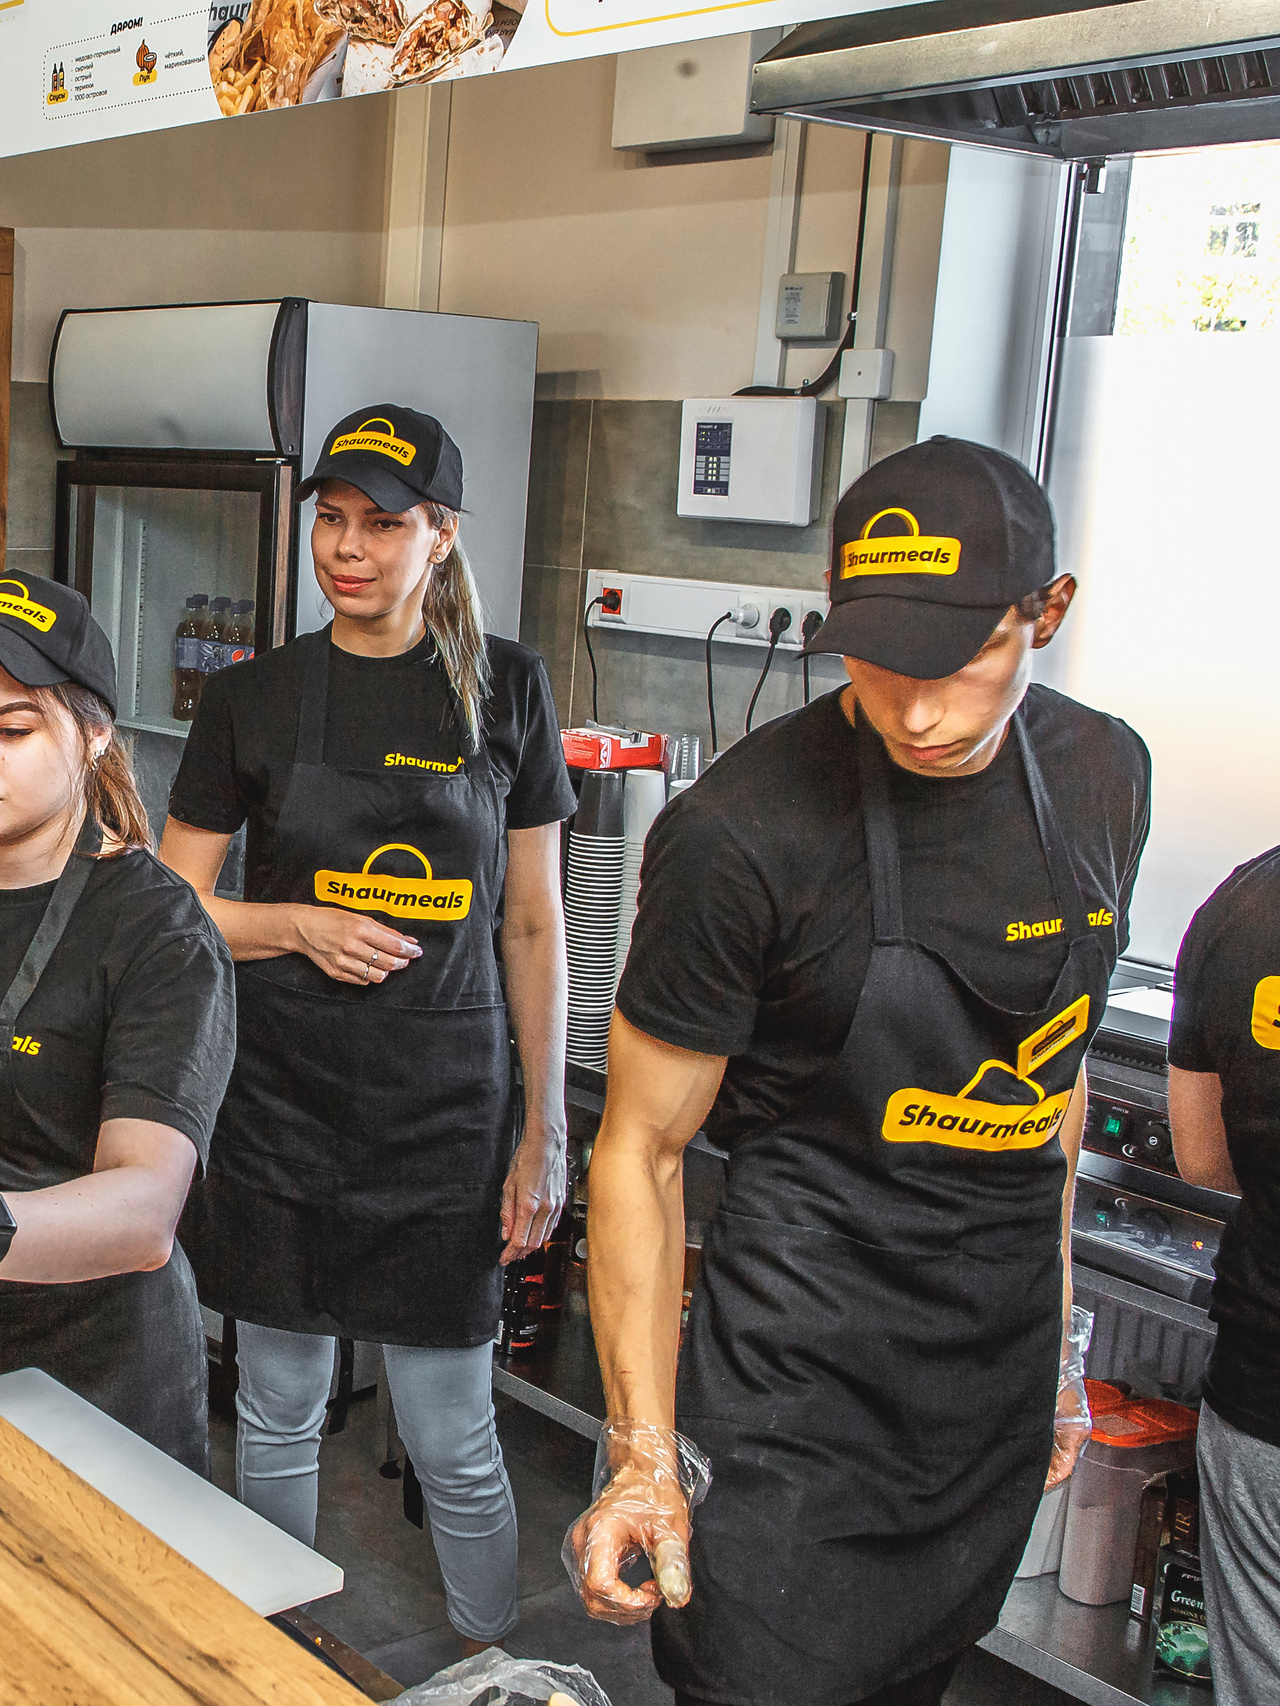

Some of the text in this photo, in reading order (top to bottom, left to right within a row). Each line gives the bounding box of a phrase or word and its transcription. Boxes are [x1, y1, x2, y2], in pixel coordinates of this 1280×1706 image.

[110, 17, 143, 36] ДАРОМ!
[75, 46, 121, 63] медово-горчичный
[164, 54, 205, 70] маринованный
[75, 62, 94, 73] сырный
[75, 72, 92, 82] острый
[139, 73, 150, 82] Лук
[74, 83, 94, 92] терияки
[74, 90, 108, 101] 1000 островов
[49, 92, 66, 102] Соусы
[335, 437, 409, 459] Shaurmeals
[847, 548, 951, 568] Shaurmeals
[384, 752, 464, 773] Shaurme
[326, 880, 464, 909] Shaurmeals
[899, 1104, 1063, 1139] Shaurmeals
[1171, 1589, 1204, 1610] Green
